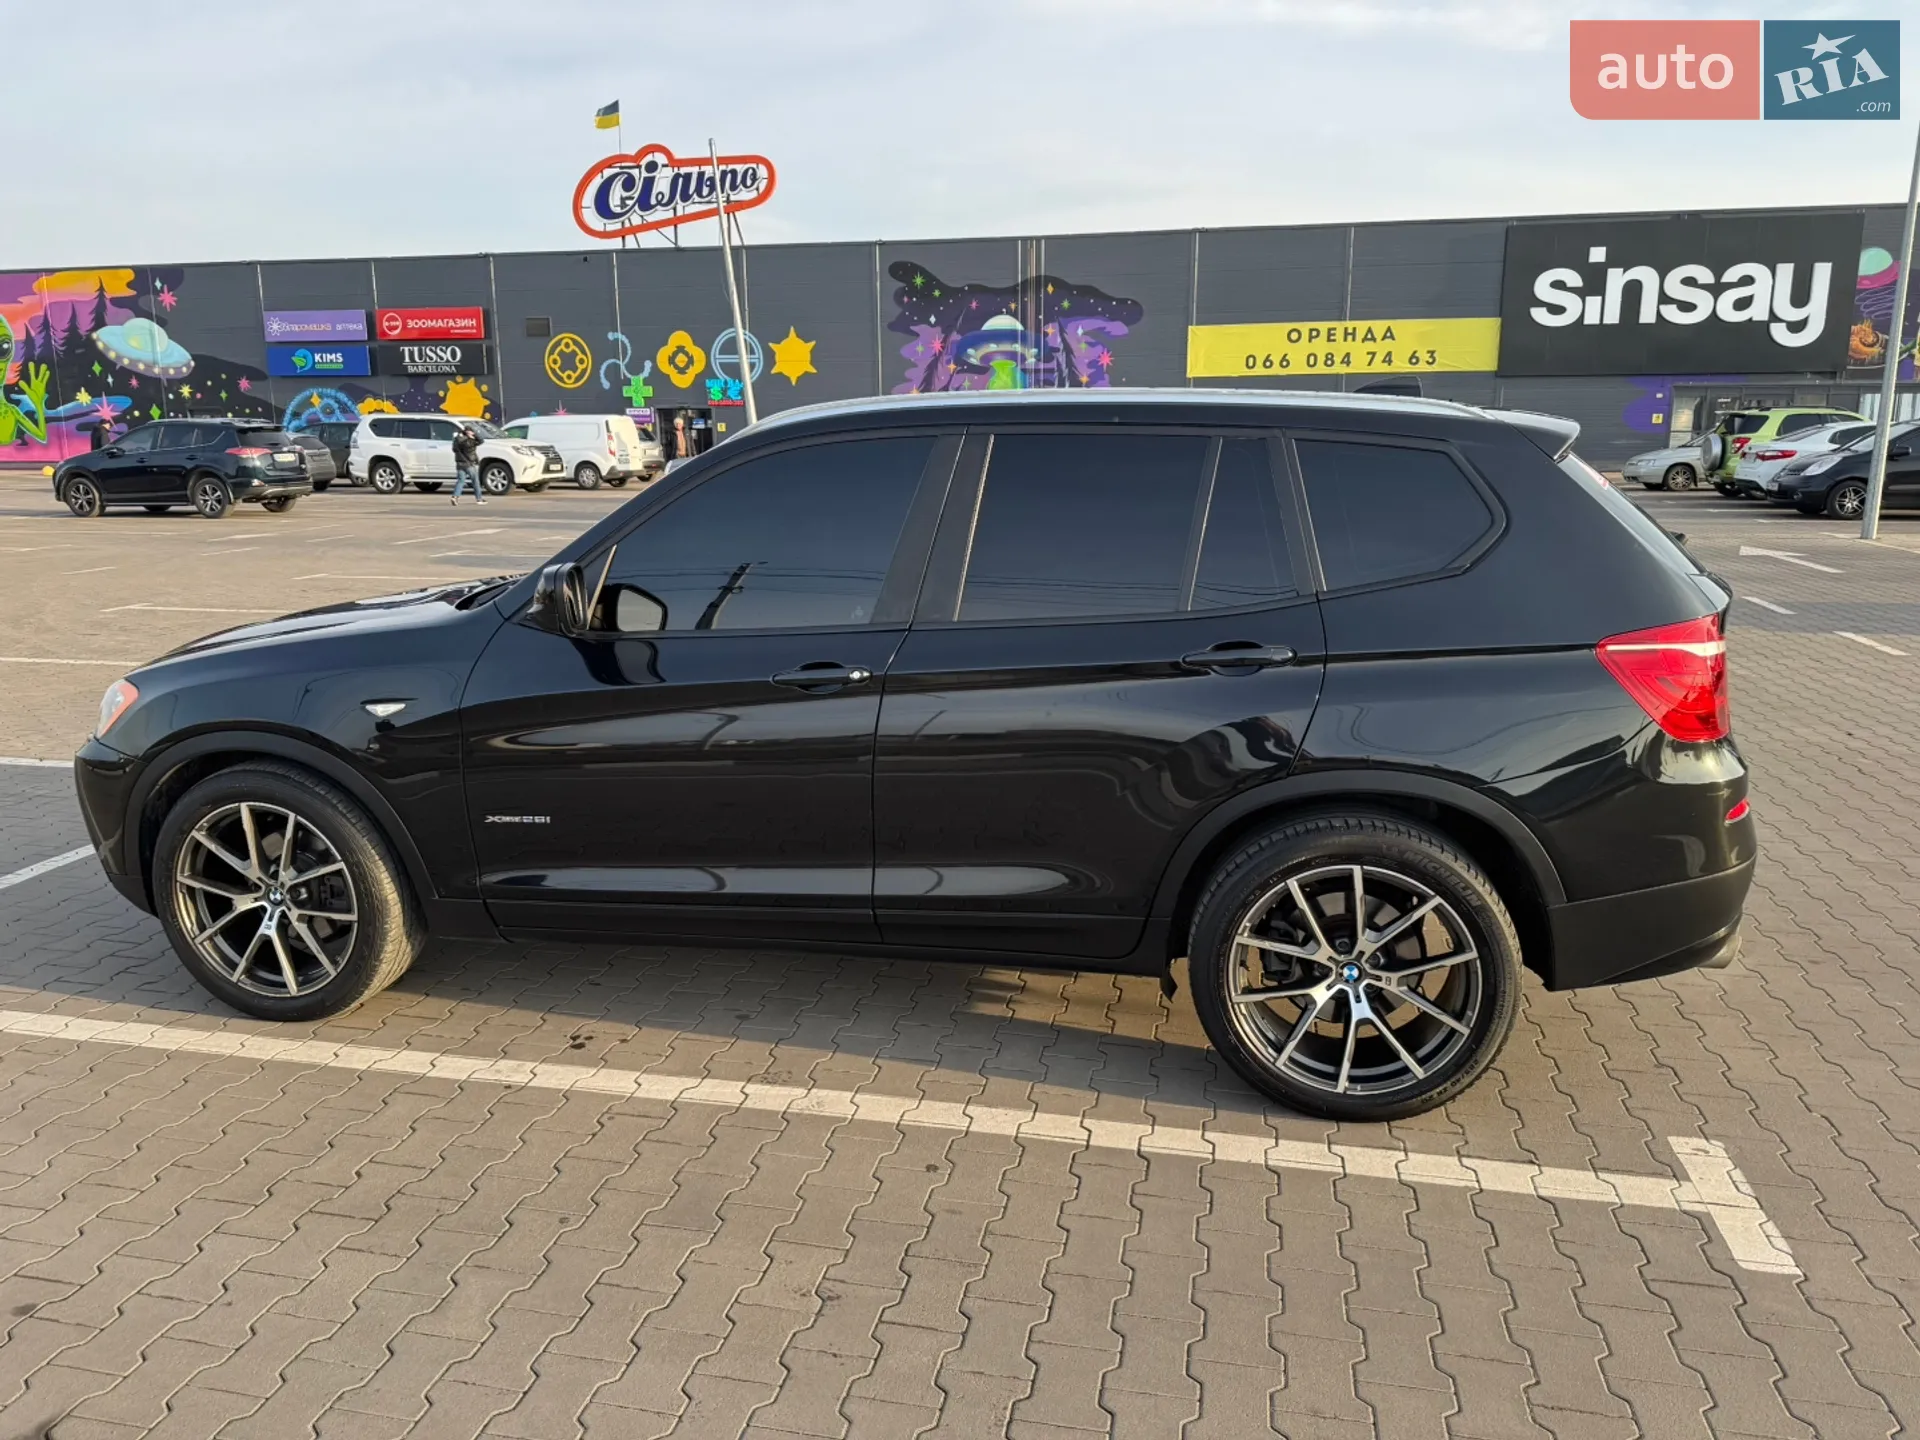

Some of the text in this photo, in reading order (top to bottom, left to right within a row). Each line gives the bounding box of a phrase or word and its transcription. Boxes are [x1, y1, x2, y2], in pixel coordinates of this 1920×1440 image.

[593, 160, 758, 221] Сільпо
[1529, 246, 1833, 347] sinsay
[406, 318, 477, 329] ЗООМАГАЗИН
[1286, 325, 1396, 344] ОРЕНДА
[314, 353, 344, 363] KIMS
[400, 345, 462, 363] TUSSO
[1244, 349, 1438, 370] 066 084 74 63
[407, 365, 457, 374] BARCELONA
[1402, 850, 1483, 908] MICHELIN
